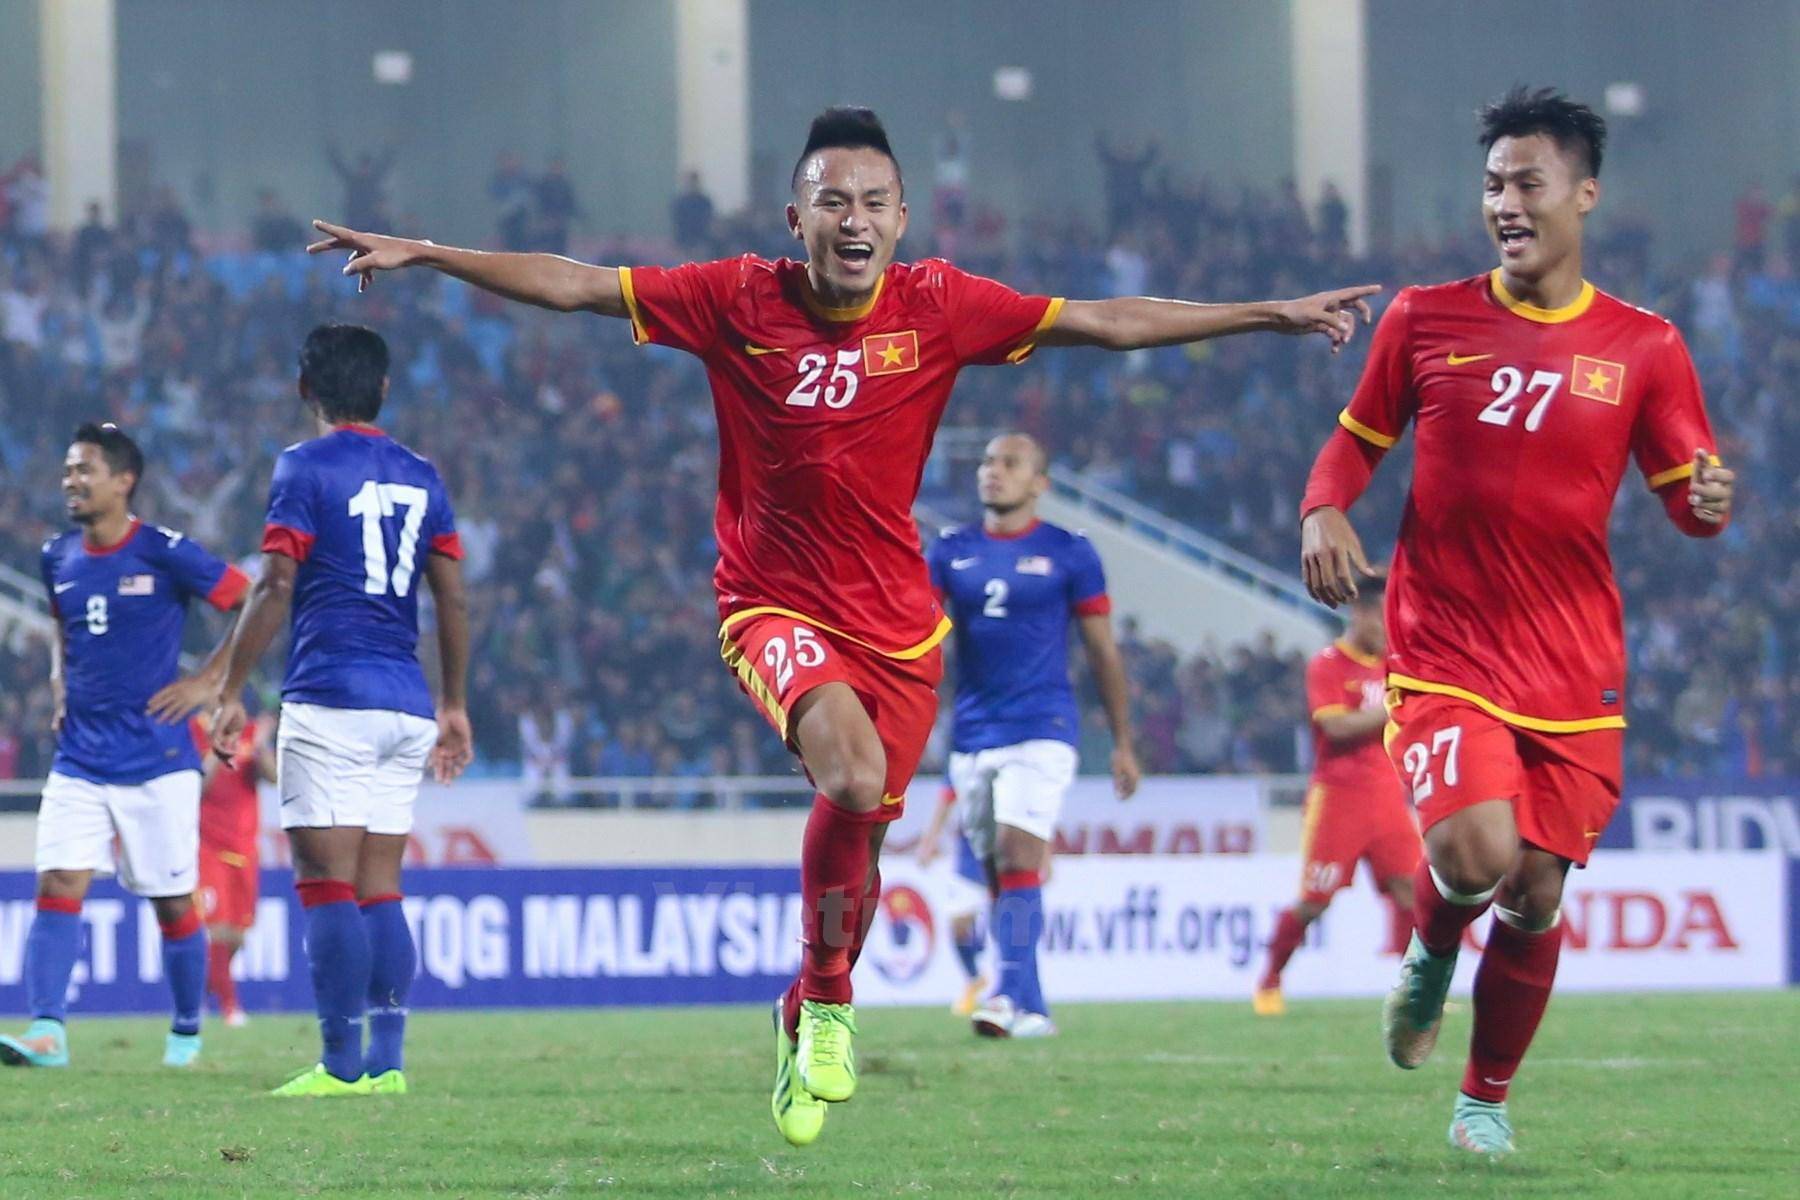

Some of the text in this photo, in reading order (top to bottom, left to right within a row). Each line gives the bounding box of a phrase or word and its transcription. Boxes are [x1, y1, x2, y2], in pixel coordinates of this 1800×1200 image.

[785, 349, 862, 410] 25
[1477, 365, 1563, 433] 27
[347, 479, 429, 598] 17
[86, 594, 109, 635] 8
[983, 577, 1009, 618] 2
[764, 626, 826, 695] 25
[1403, 725, 1462, 806] 27
